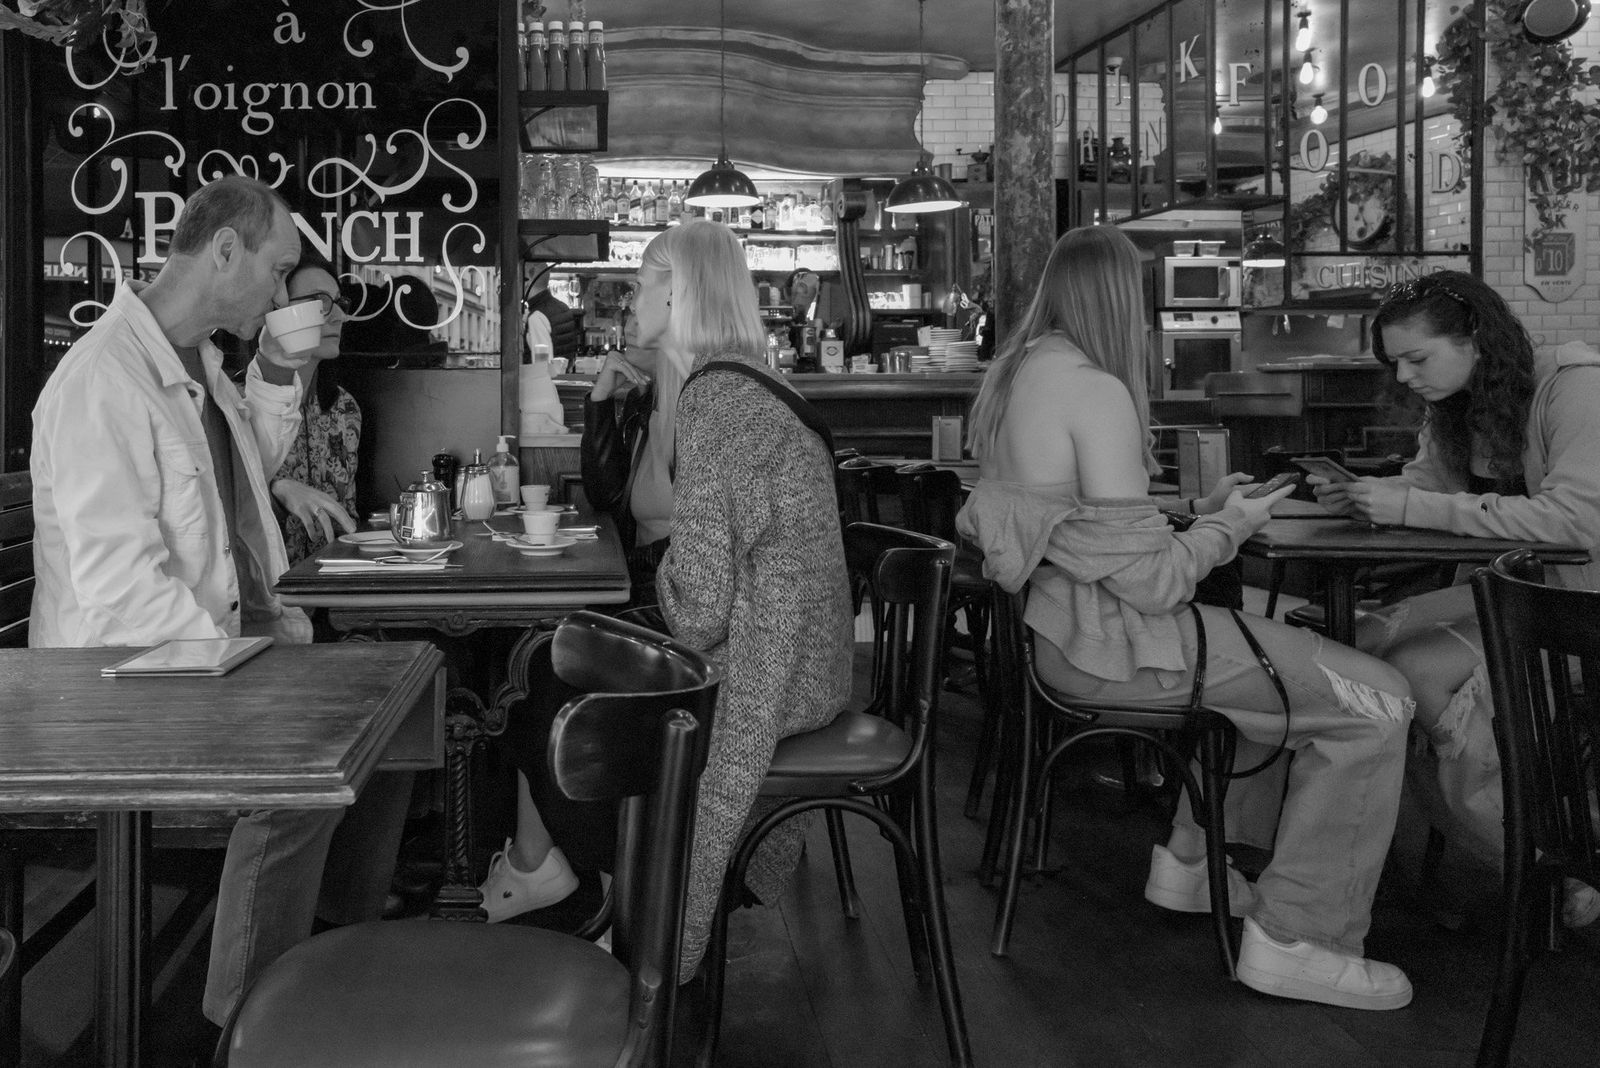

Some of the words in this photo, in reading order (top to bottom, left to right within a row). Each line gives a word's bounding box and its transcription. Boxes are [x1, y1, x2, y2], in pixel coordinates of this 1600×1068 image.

[273, 0, 306, 44] à
[158, 54, 377, 136] l'oignon
[134, 191, 425, 264] BNCH
[1316, 262, 1446, 289] CUISIN
